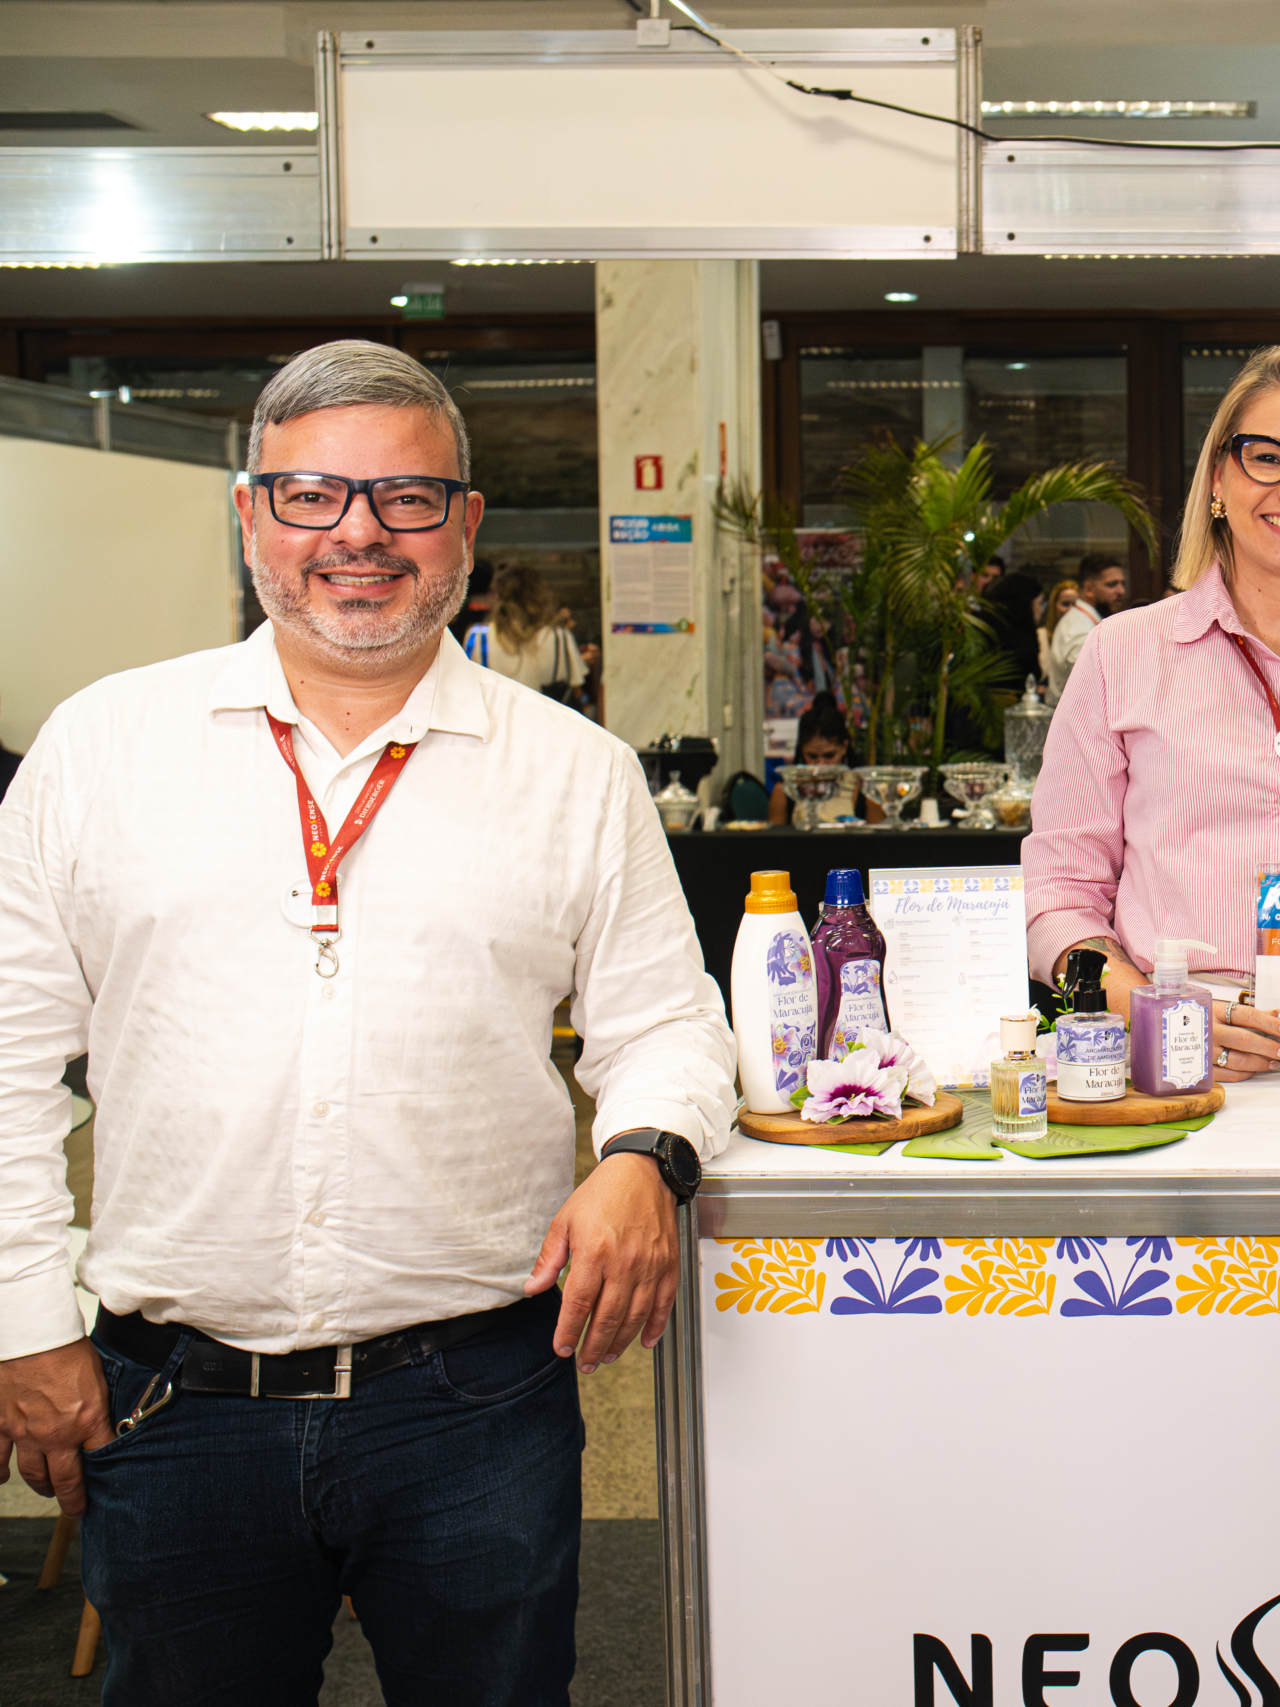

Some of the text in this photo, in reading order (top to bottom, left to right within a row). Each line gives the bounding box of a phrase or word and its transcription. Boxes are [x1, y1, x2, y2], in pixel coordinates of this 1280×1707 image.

[306, 799, 319, 842] NEOSENSE
[895, 895, 1011, 917] Flor de Maracujá
[777, 992, 809, 1006] Flor de
[773, 1004, 813, 1018] Maracujá
[848, 1001, 876, 1012] Flor de
[844, 1011, 880, 1021] Maracujá
[1190, 1034, 1199, 1042] de
[1170, 1043, 1202, 1052] Maracujá
[1089, 1065, 1120, 1076] Flor de
[1024, 1086, 1040, 1094] Flor
